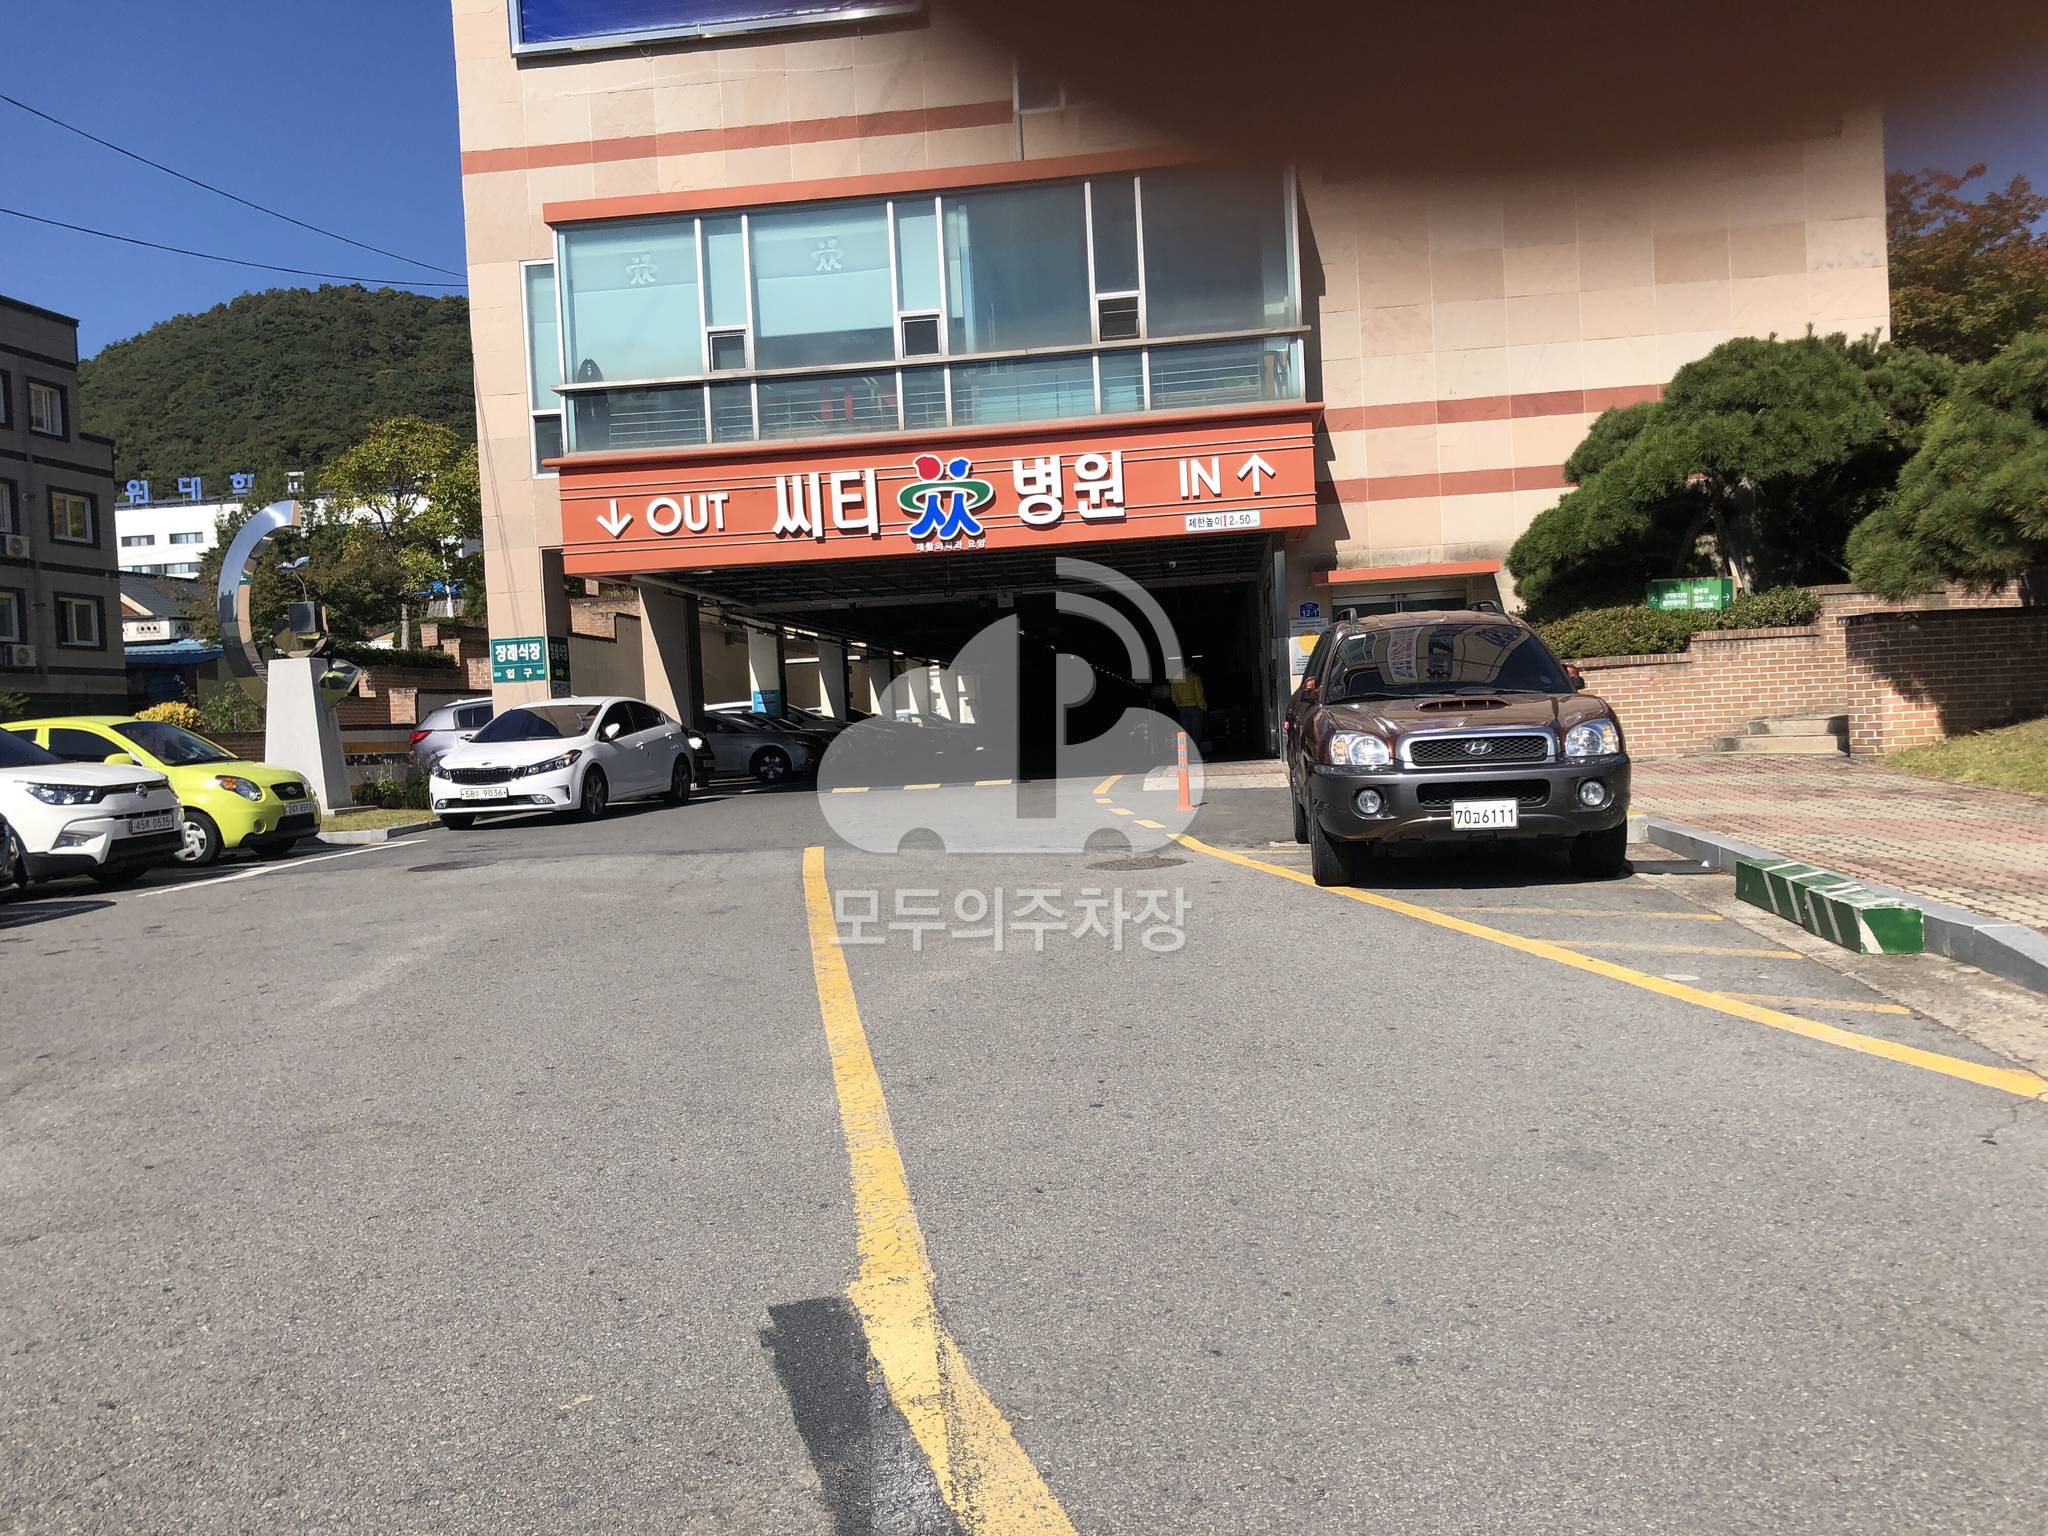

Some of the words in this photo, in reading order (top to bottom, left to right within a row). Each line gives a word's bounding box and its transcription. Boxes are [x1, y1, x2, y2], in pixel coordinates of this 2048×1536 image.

[772, 468, 880, 538] 씨티
[1012, 450, 1126, 526] 병원
[1179, 457, 1221, 500] IN
[646, 492, 729, 534] OUT
[1188, 515, 1223, 528] 제한높이
[495, 642, 541, 662] 장례식장
[1455, 808, 1514, 825] 70고6111
